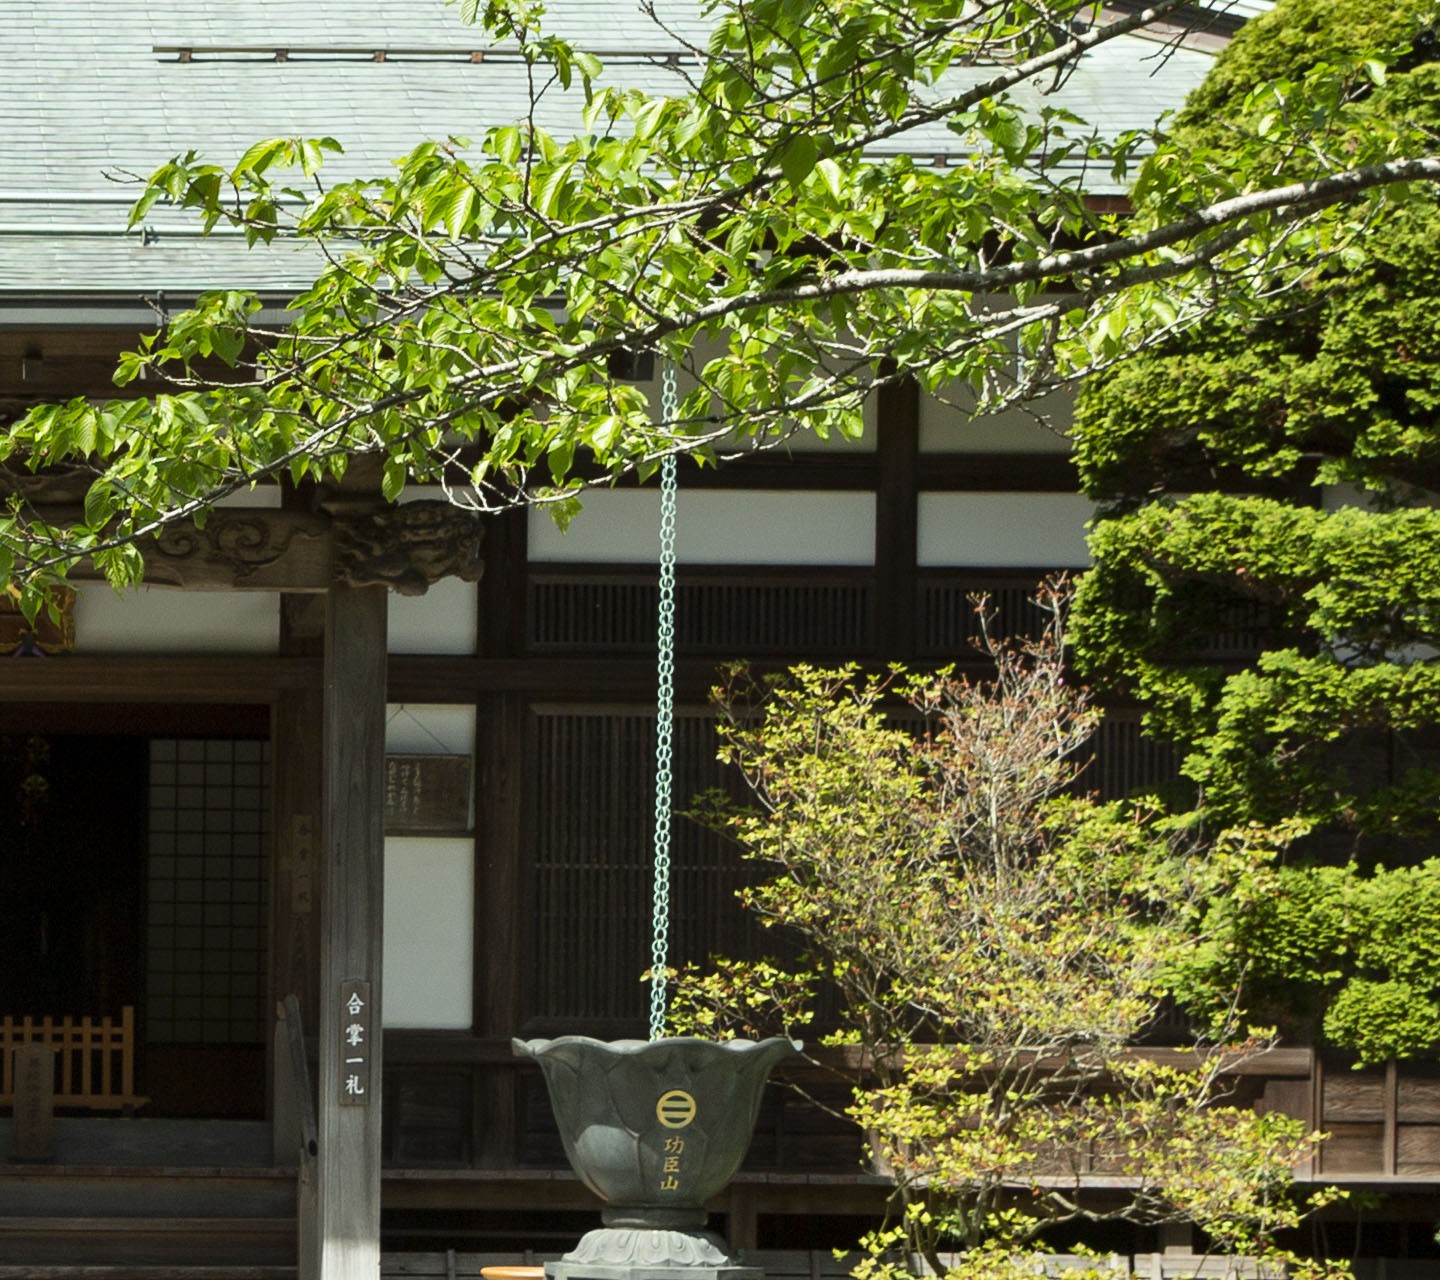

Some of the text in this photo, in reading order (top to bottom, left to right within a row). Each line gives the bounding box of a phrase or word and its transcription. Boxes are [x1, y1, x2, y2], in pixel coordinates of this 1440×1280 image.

[345, 992, 365, 1095] 合掌一礼
[660, 1136, 685, 1191] 功臣山
